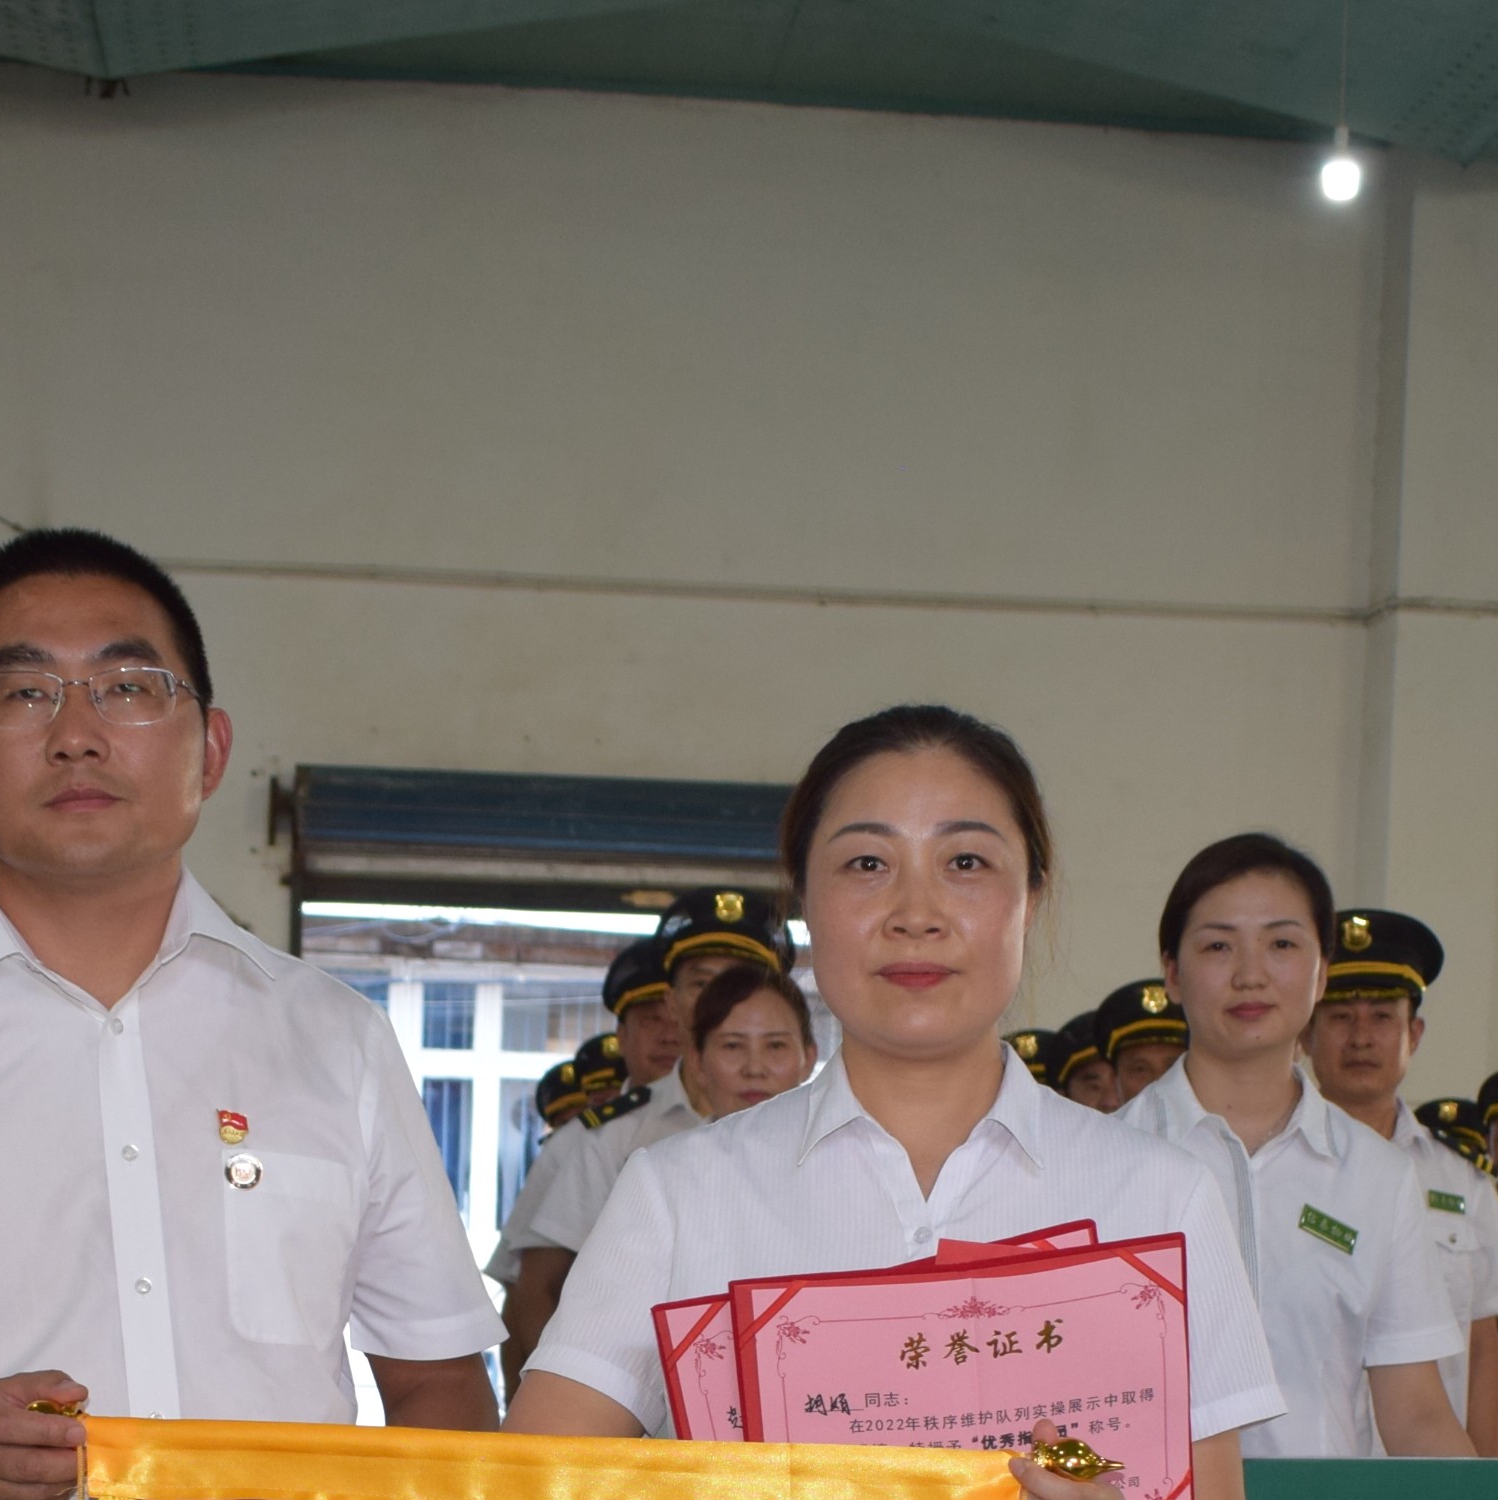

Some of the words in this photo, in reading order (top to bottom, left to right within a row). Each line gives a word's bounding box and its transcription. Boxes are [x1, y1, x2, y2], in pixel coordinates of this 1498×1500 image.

[899, 1318, 1064, 1370] 荣誉证书
[848, 1387, 1155, 1434] 在2022年秩序维护队列实操展示中取得
